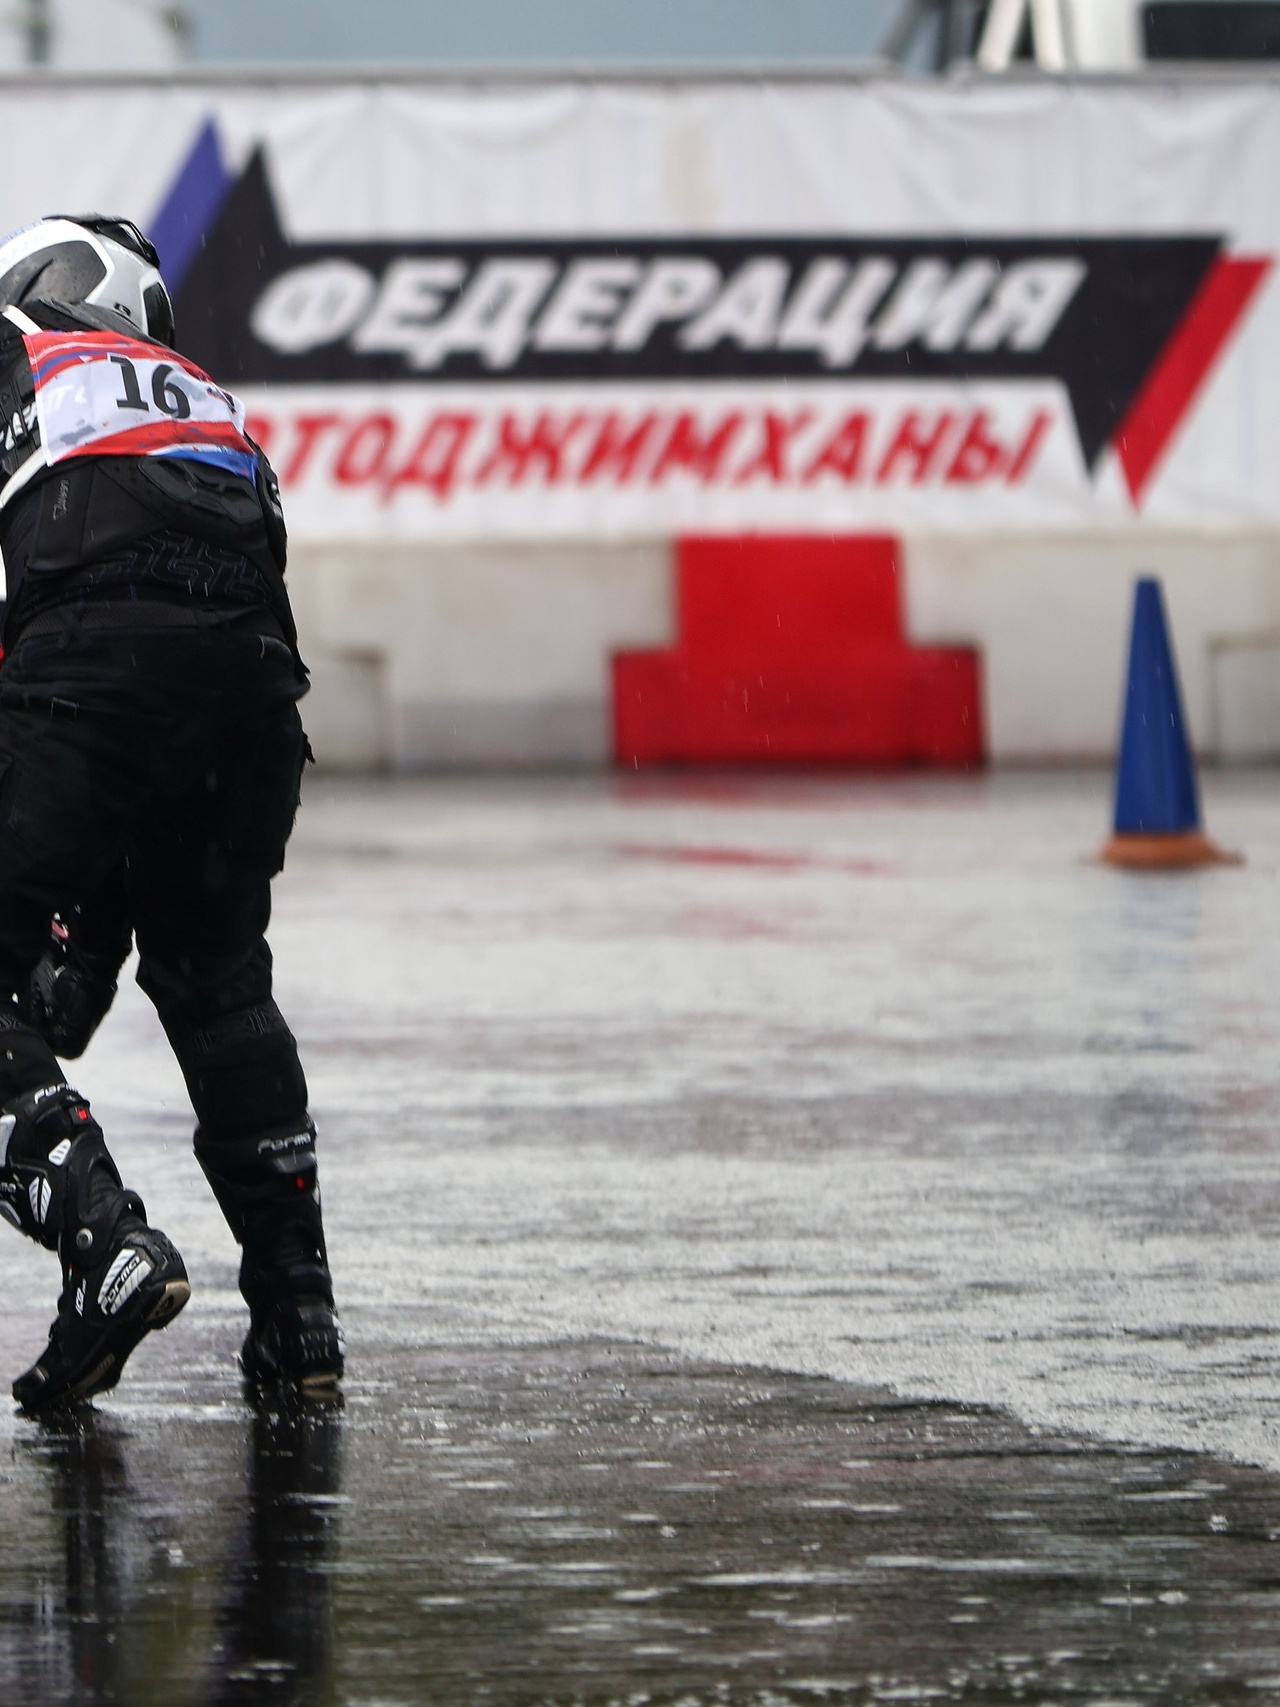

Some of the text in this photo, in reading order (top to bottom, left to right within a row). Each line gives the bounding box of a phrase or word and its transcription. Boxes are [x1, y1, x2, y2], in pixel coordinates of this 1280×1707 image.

[253, 257, 1086, 370] ФЕДЕРАЦИЯ
[107, 355, 191, 420] 16
[245, 410, 1051, 503] ТОДЖИМХАНЫ
